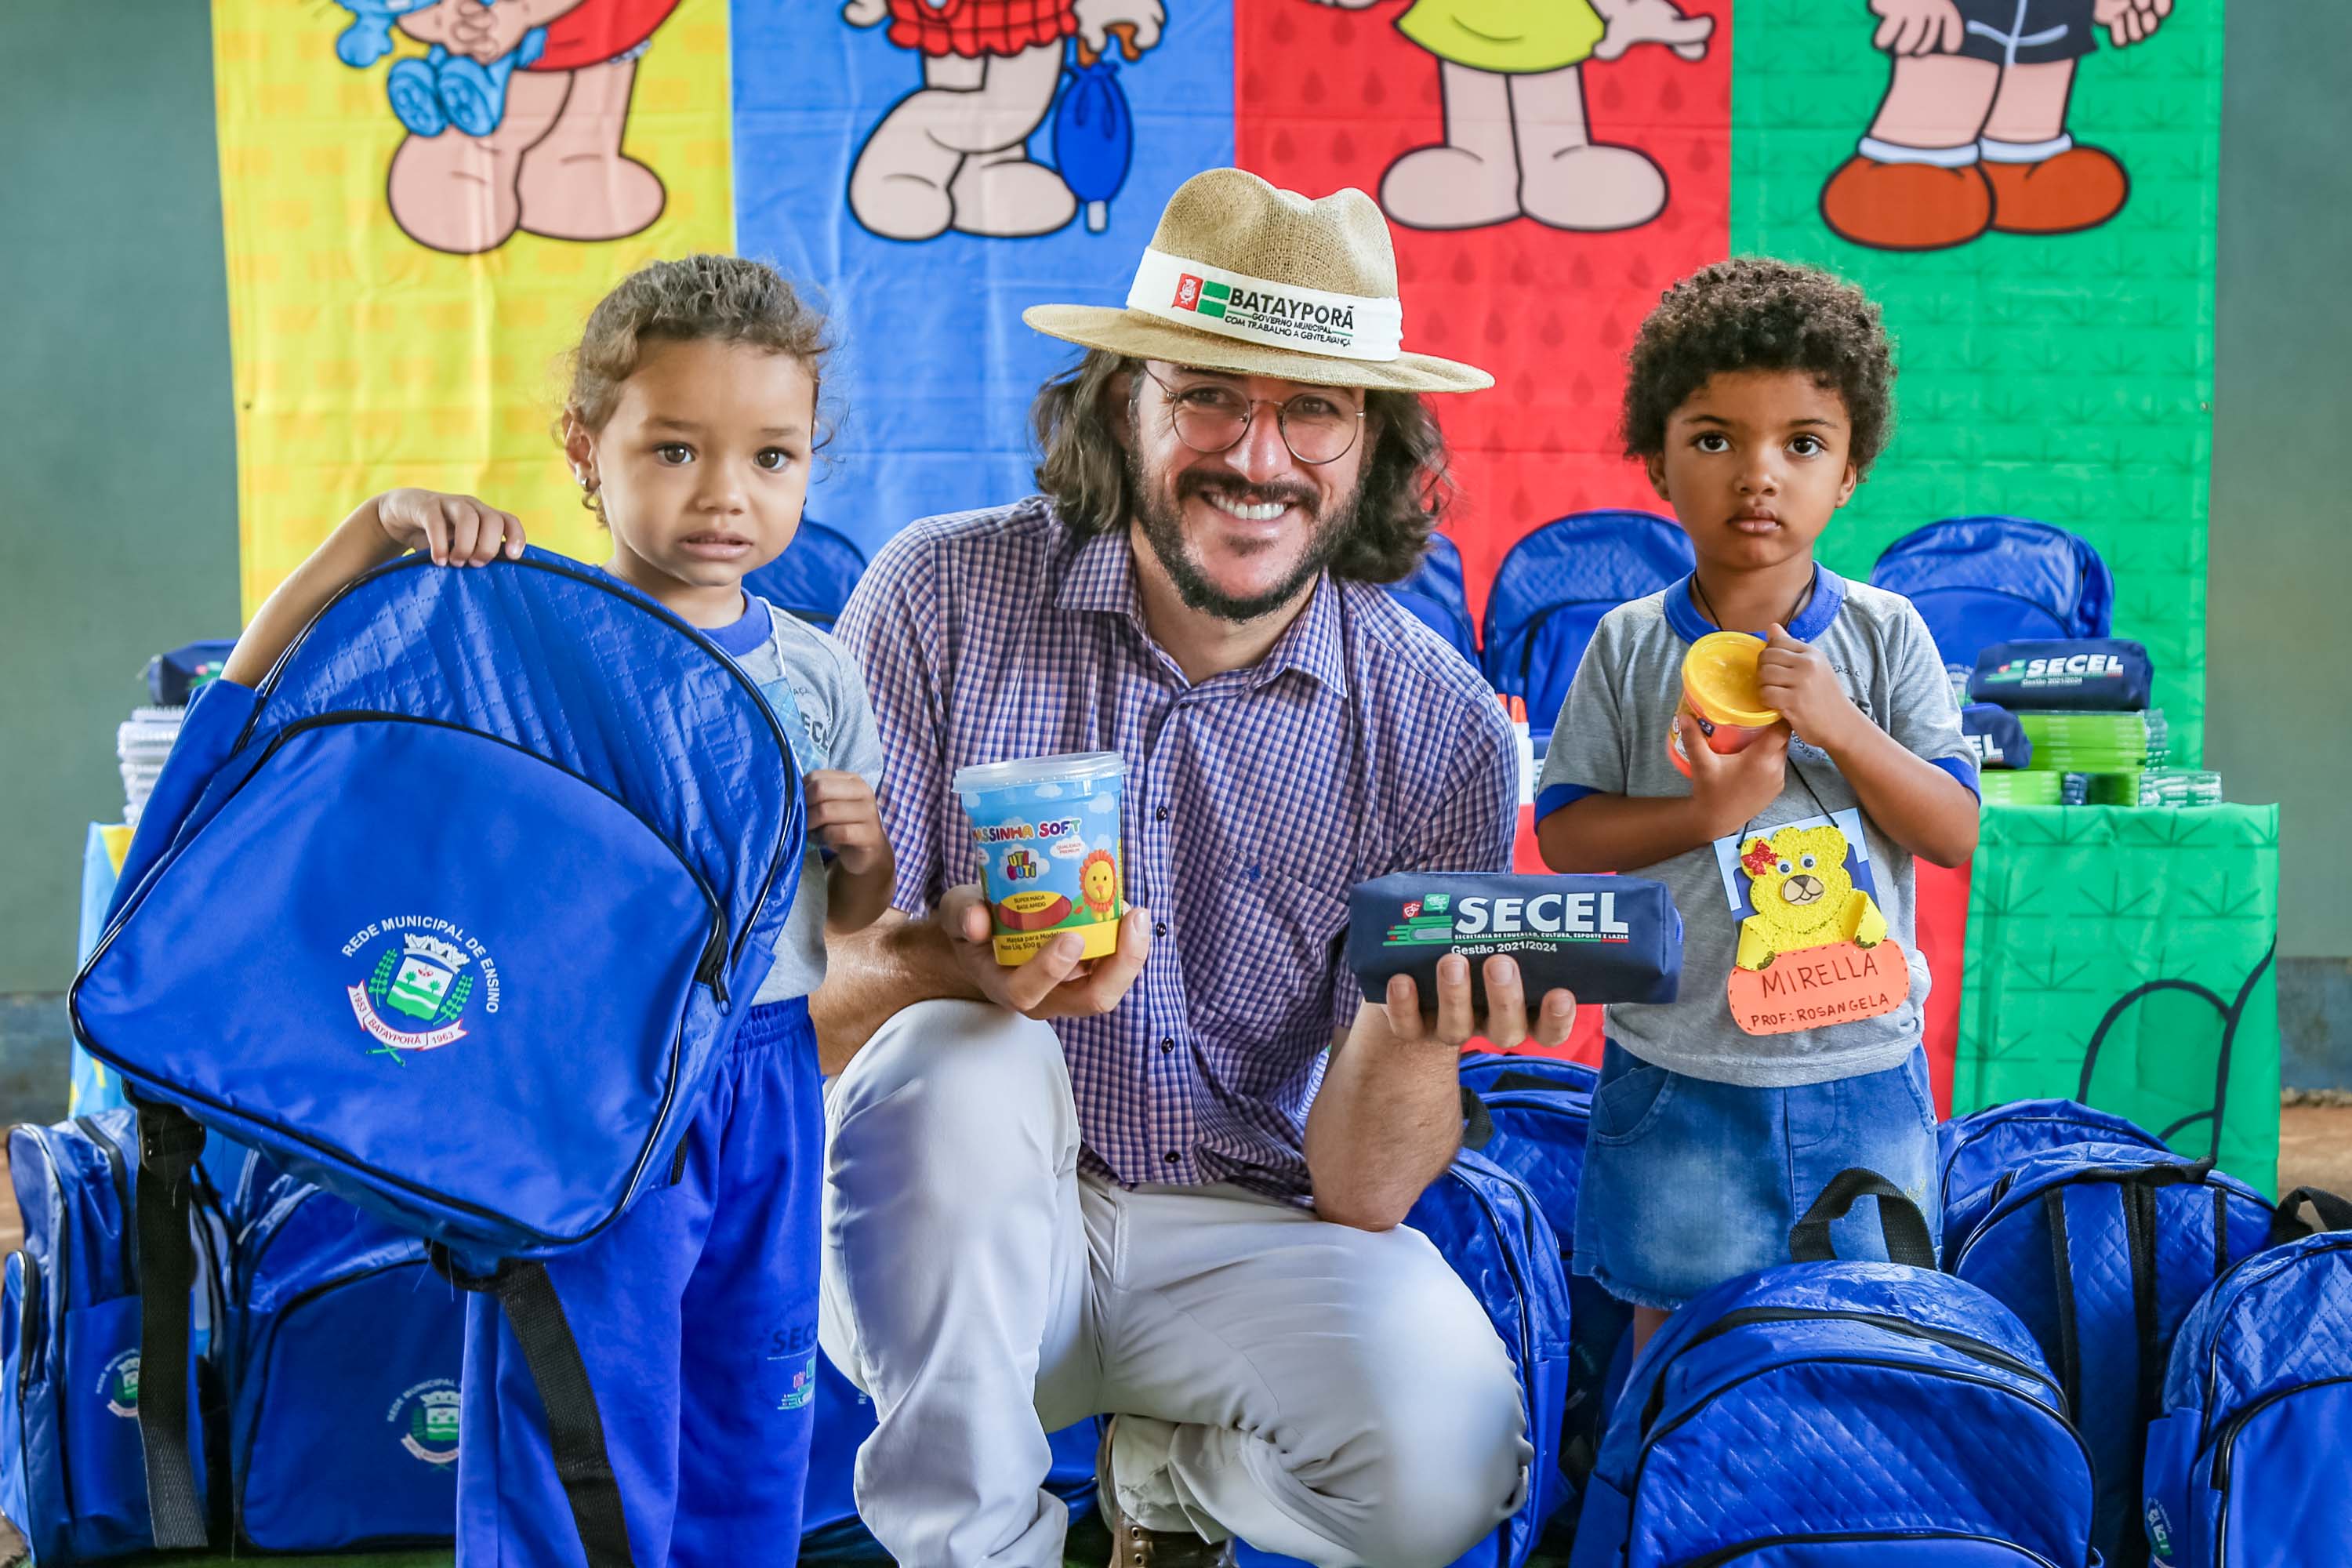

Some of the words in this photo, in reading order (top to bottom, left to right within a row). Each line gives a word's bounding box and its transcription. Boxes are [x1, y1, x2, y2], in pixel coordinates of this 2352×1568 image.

[1229, 288, 1354, 329] BATAYPORÃ
[1225, 315, 1245, 327] COM
[1248, 320, 1292, 336] TRABALHO
[1252, 313, 1292, 327] GOVERNO
[1294, 321, 1332, 334] MUNICIPAL
[2026, 654, 2124, 677] SECEL
[1040, 819, 1080, 837] SOFT
[1455, 892, 1629, 934] SECEL
[1451, 944, 1494, 955] Gestão
[1497, 940, 1558, 953] 2021/2024
[342, 924, 379, 957] REDE
[382, 916, 463, 942] MUNICIPAL
[465, 937, 486, 958] DE
[481, 957, 499, 1013] ENSINO
[1762, 953, 1878, 999] MIRELLA
[368, 1019, 421, 1044] BATAYPORÃ
[432, 1032, 454, 1044] 1963
